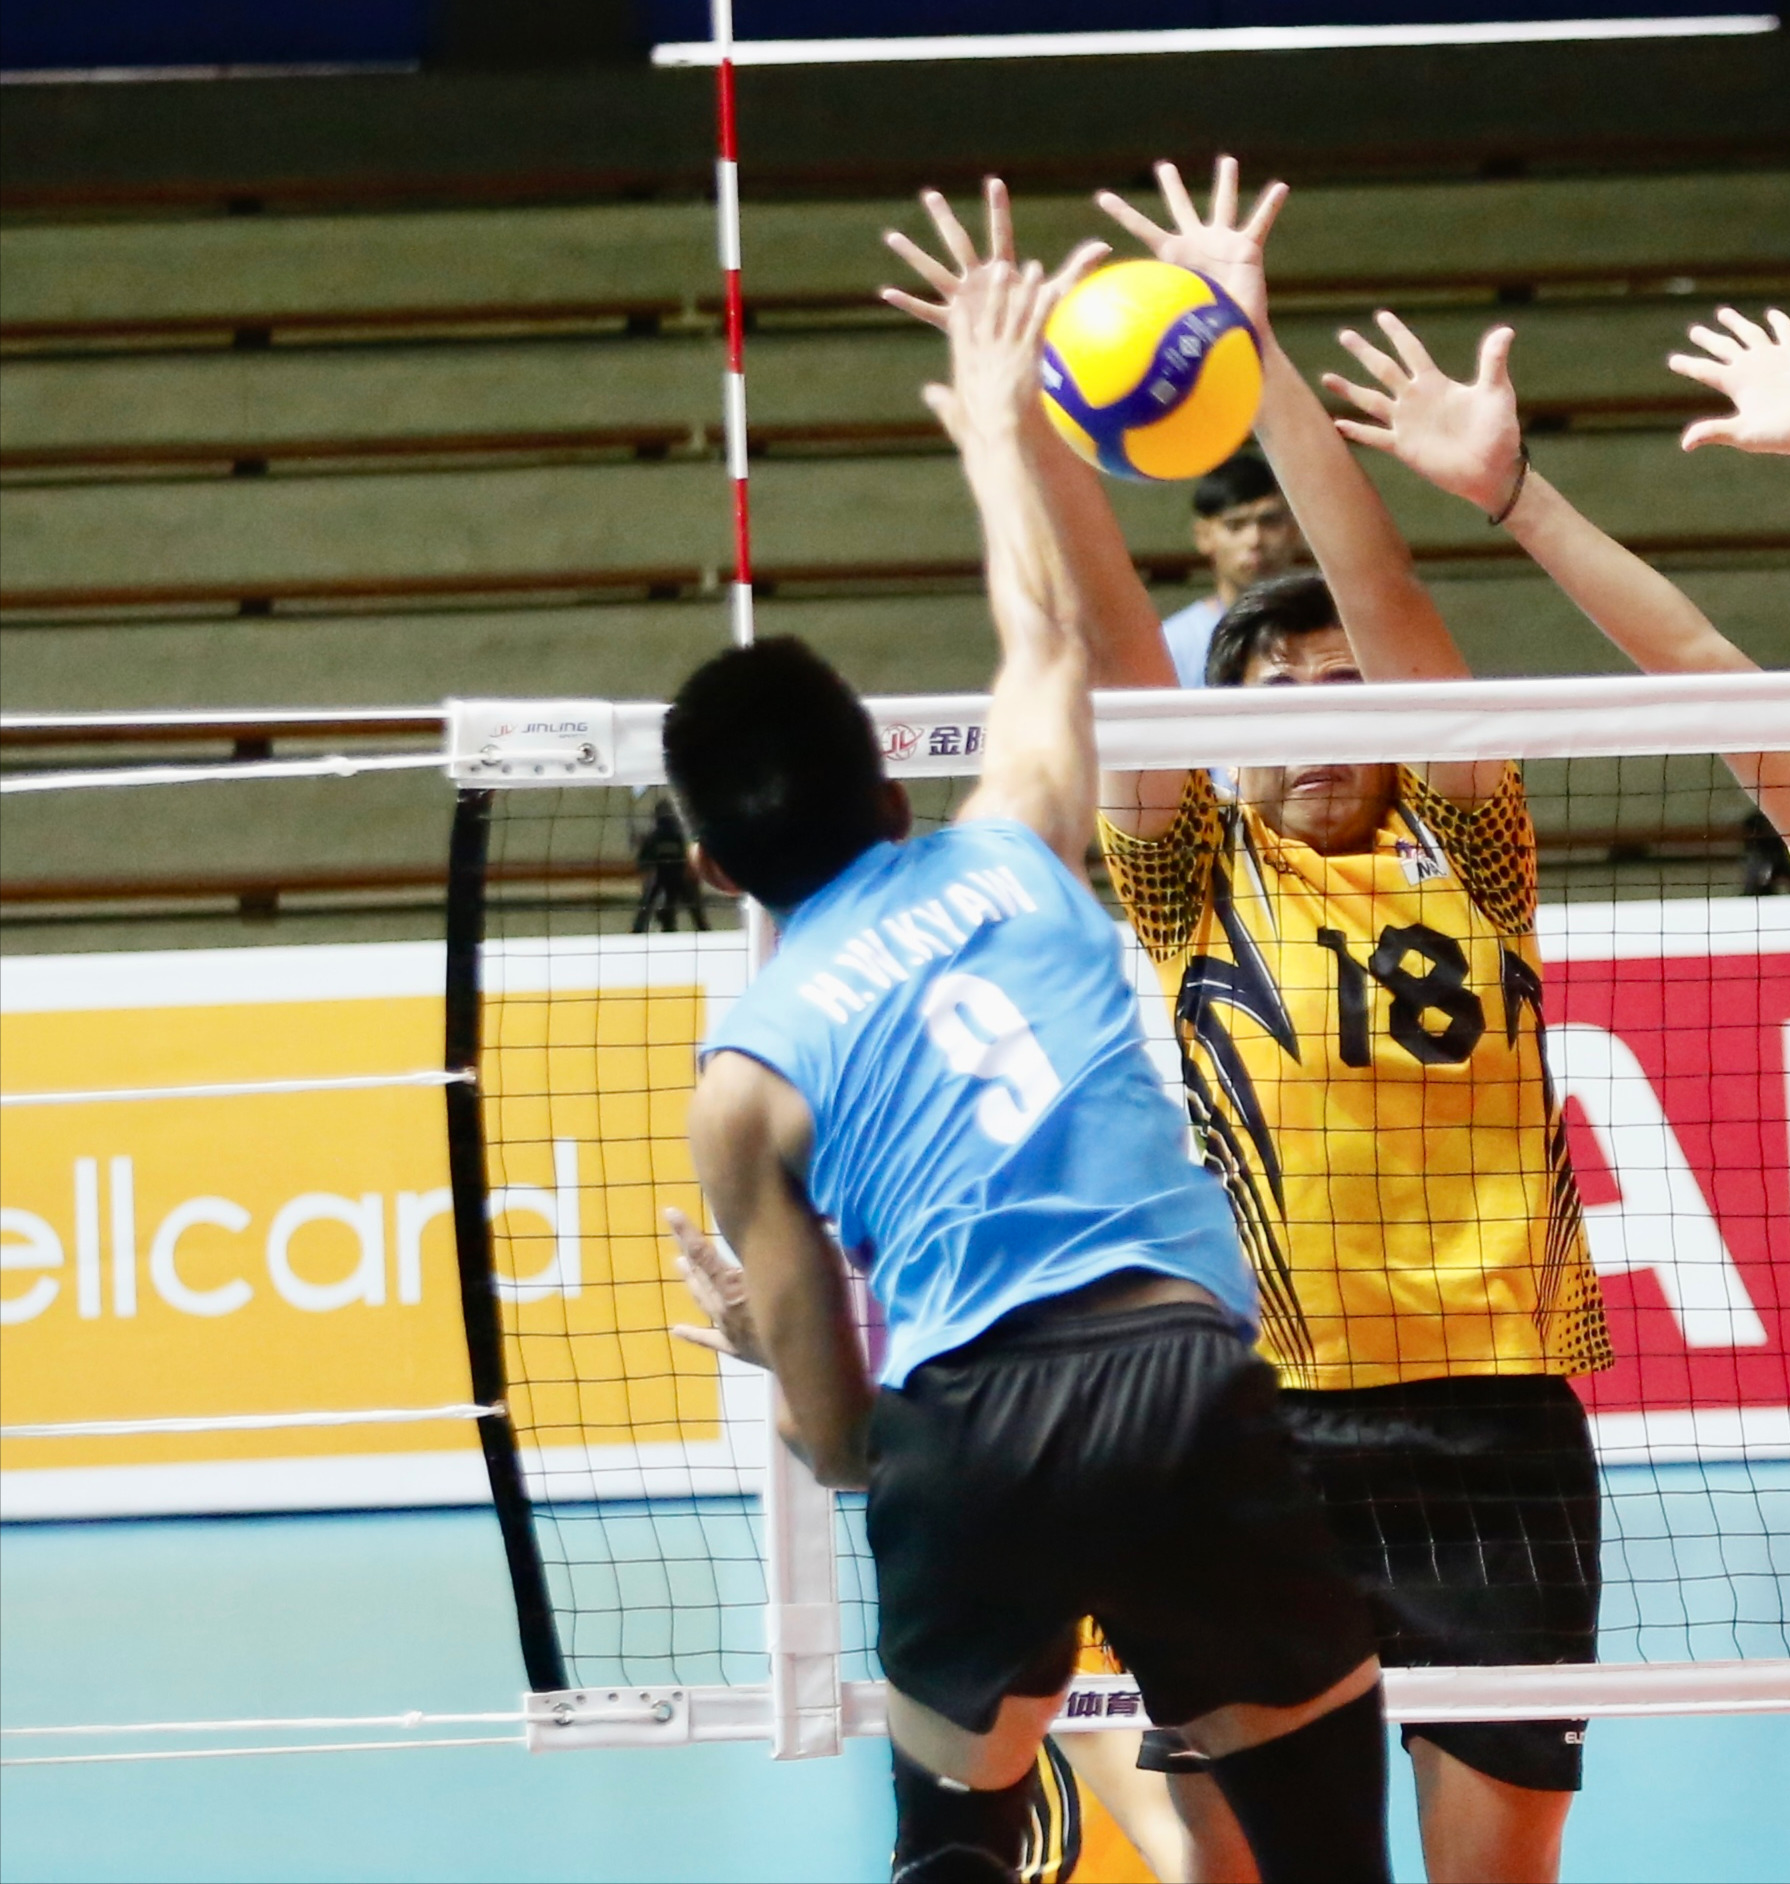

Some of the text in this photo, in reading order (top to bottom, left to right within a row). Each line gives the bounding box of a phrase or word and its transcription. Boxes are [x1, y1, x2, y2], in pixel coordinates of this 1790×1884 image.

[521, 722, 589, 733] JINLING
[921, 973, 1063, 1145] 9
[1317, 923, 1486, 1067] 18
